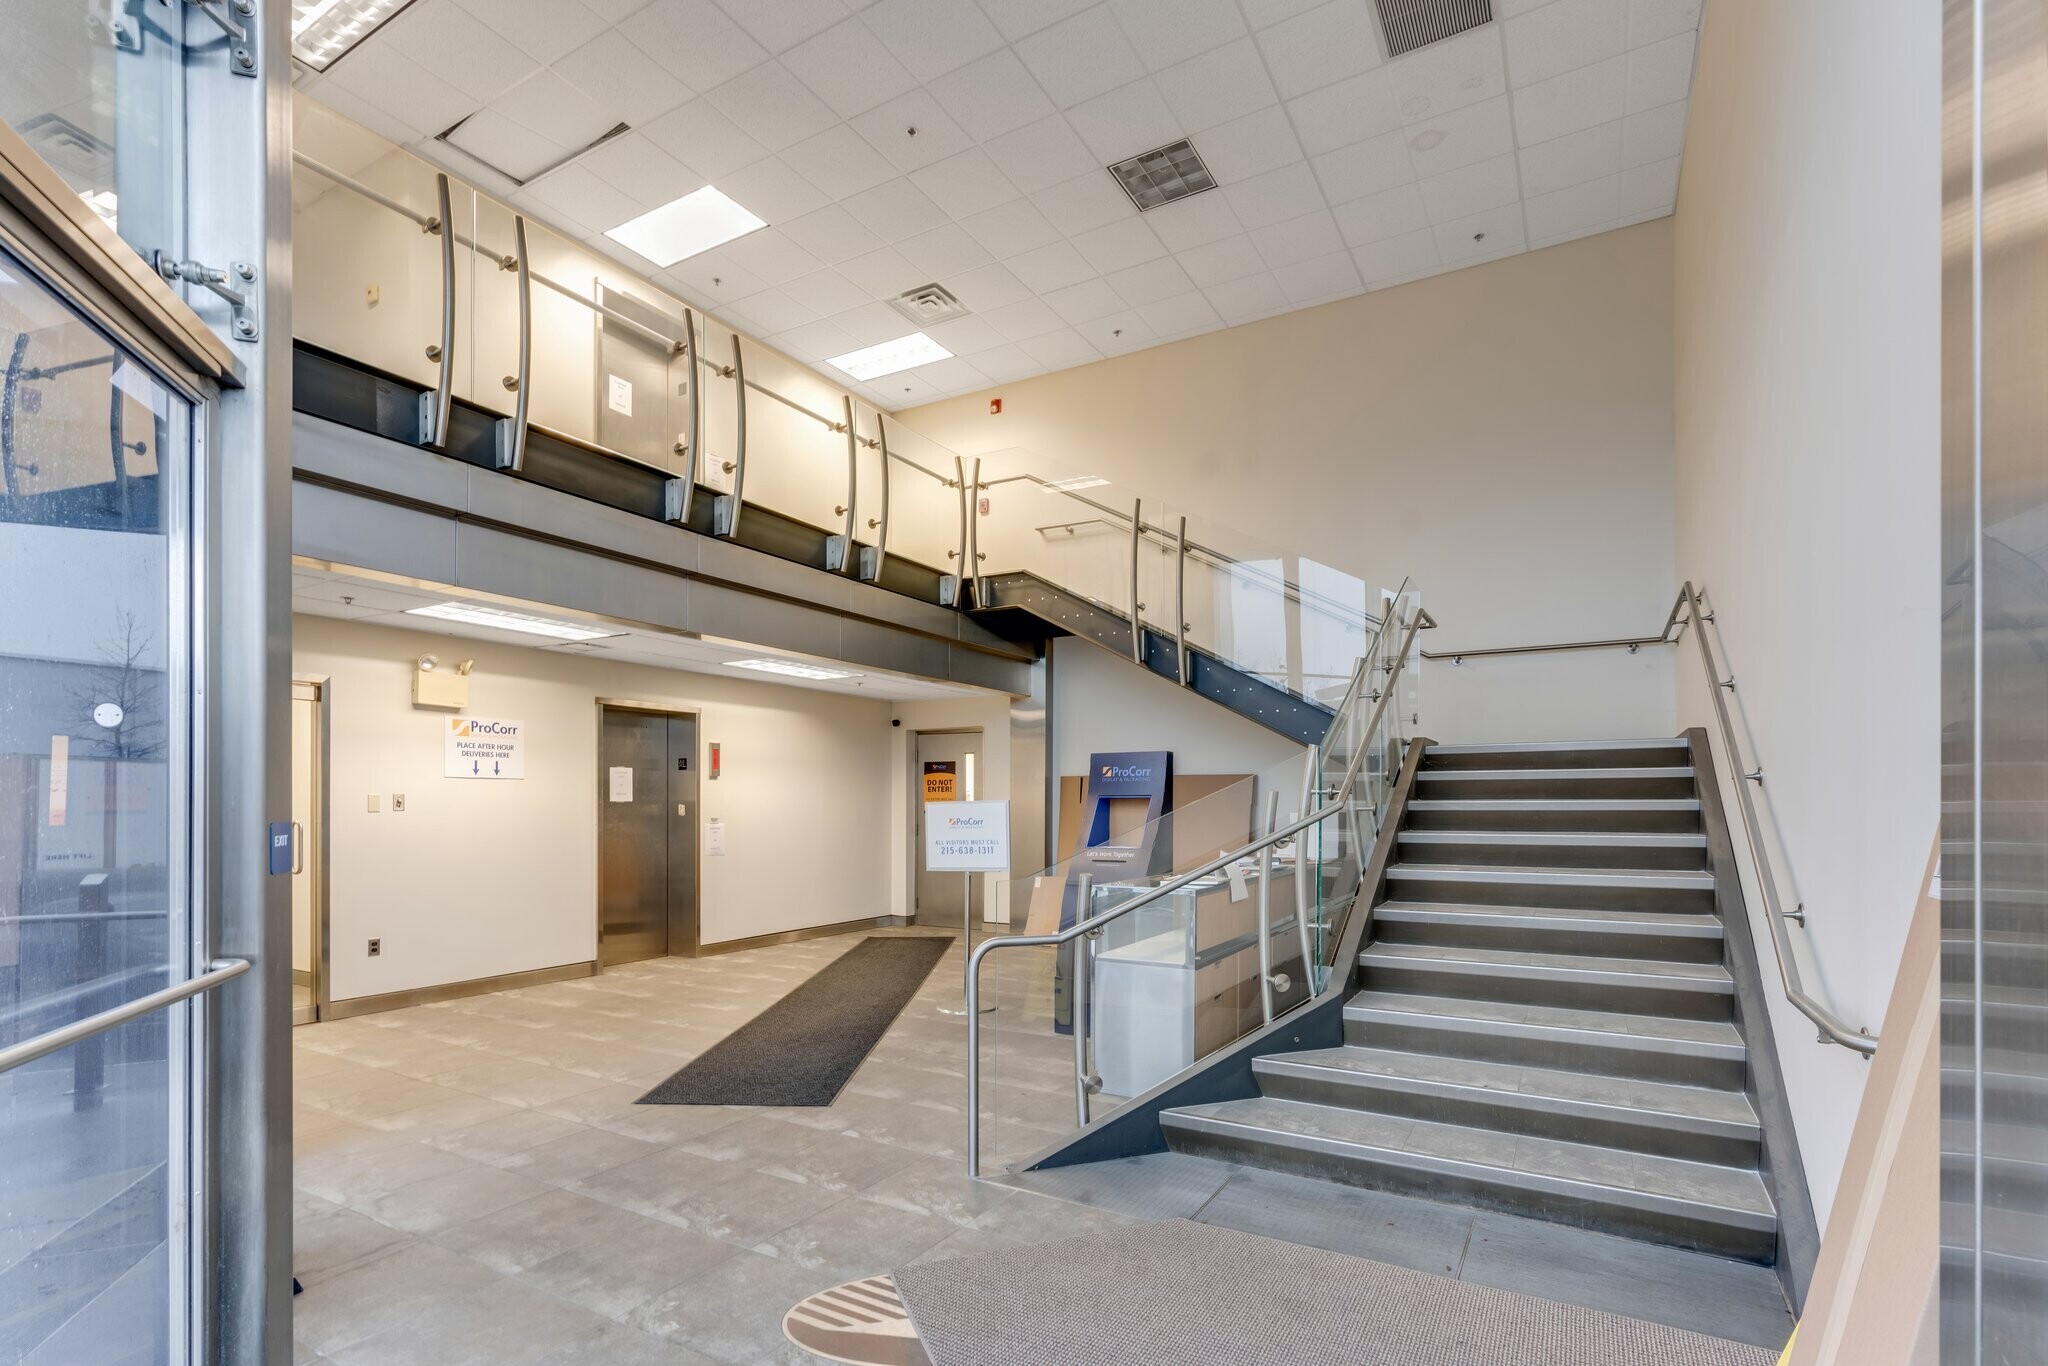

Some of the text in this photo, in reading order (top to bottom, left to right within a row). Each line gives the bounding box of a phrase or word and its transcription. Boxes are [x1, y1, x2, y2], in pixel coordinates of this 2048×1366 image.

[471, 720, 517, 735] ProCorr
[1112, 766, 1151, 777] ProCorr
[274, 834, 289, 848] EXIT
[941, 846, 994, 855] 215-638-1311
